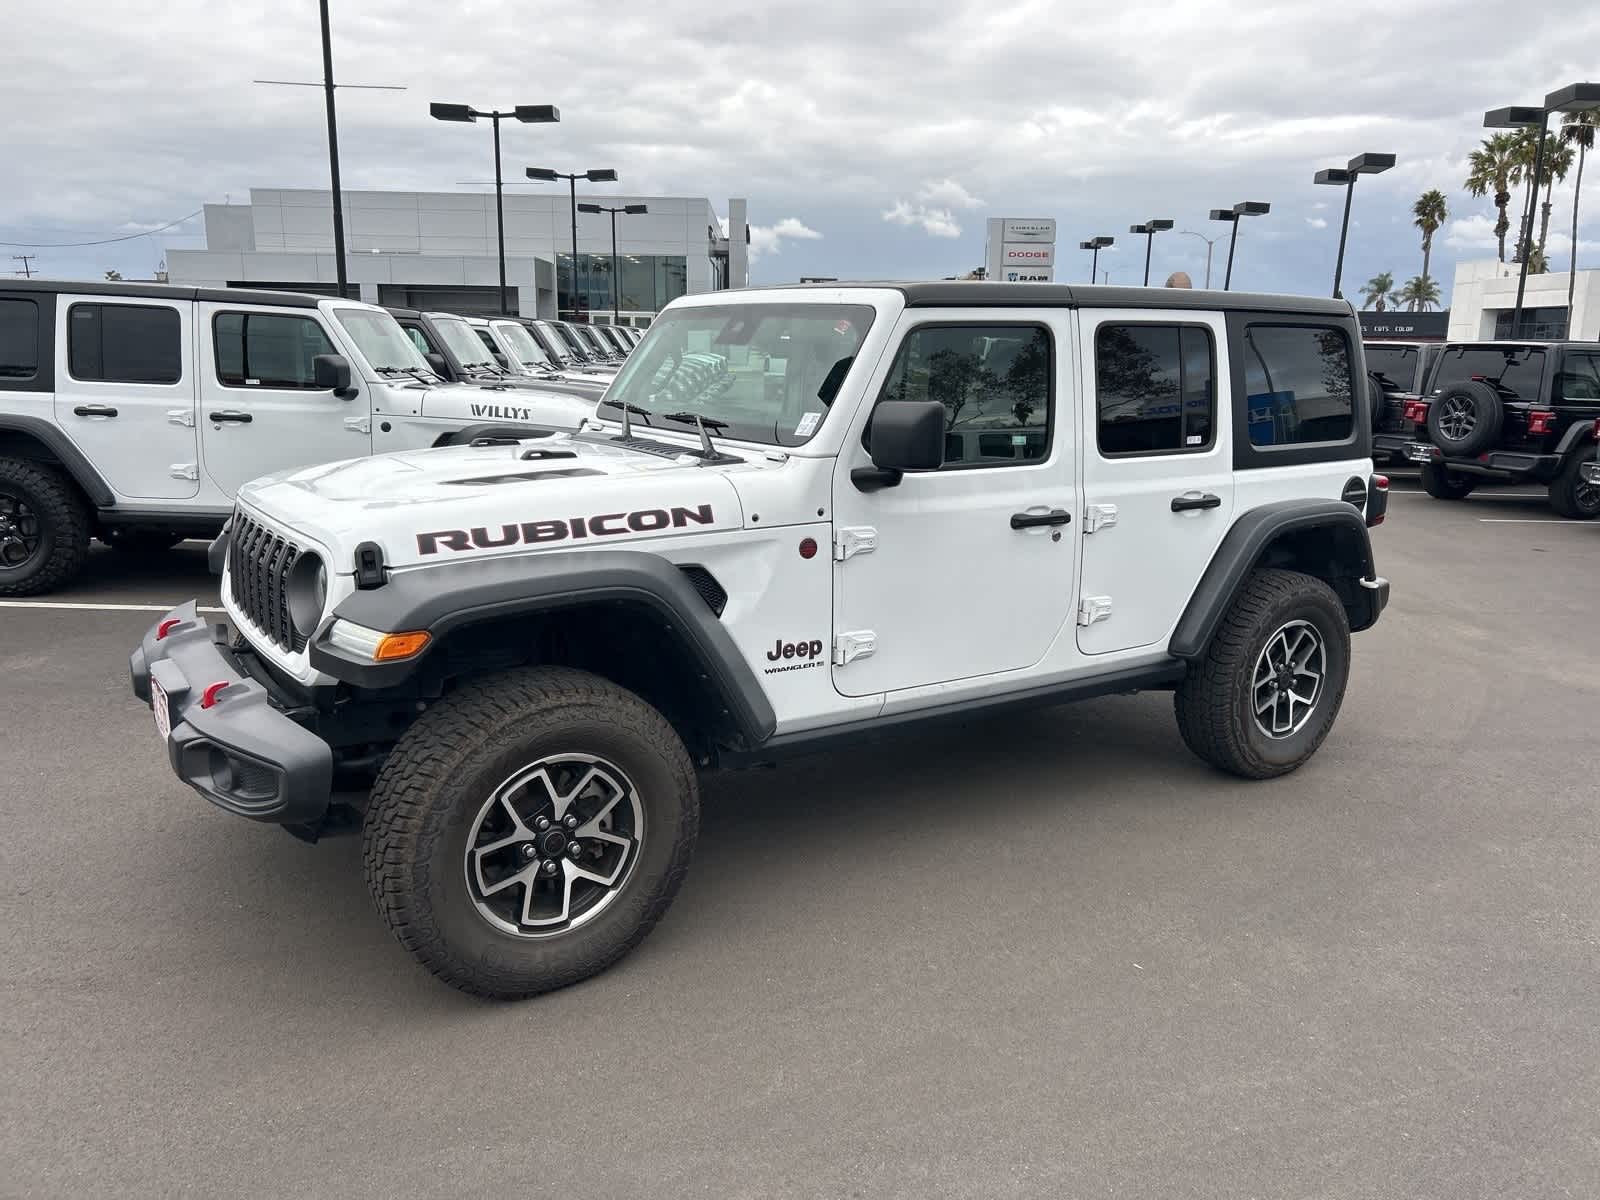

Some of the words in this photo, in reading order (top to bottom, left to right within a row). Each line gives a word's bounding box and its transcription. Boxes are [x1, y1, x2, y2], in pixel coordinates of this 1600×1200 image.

[470, 403, 531, 420] WILLYS
[416, 503, 714, 556] RUBICON
[767, 639, 823, 661] Jeep
[764, 662, 815, 675] WRANGLER
